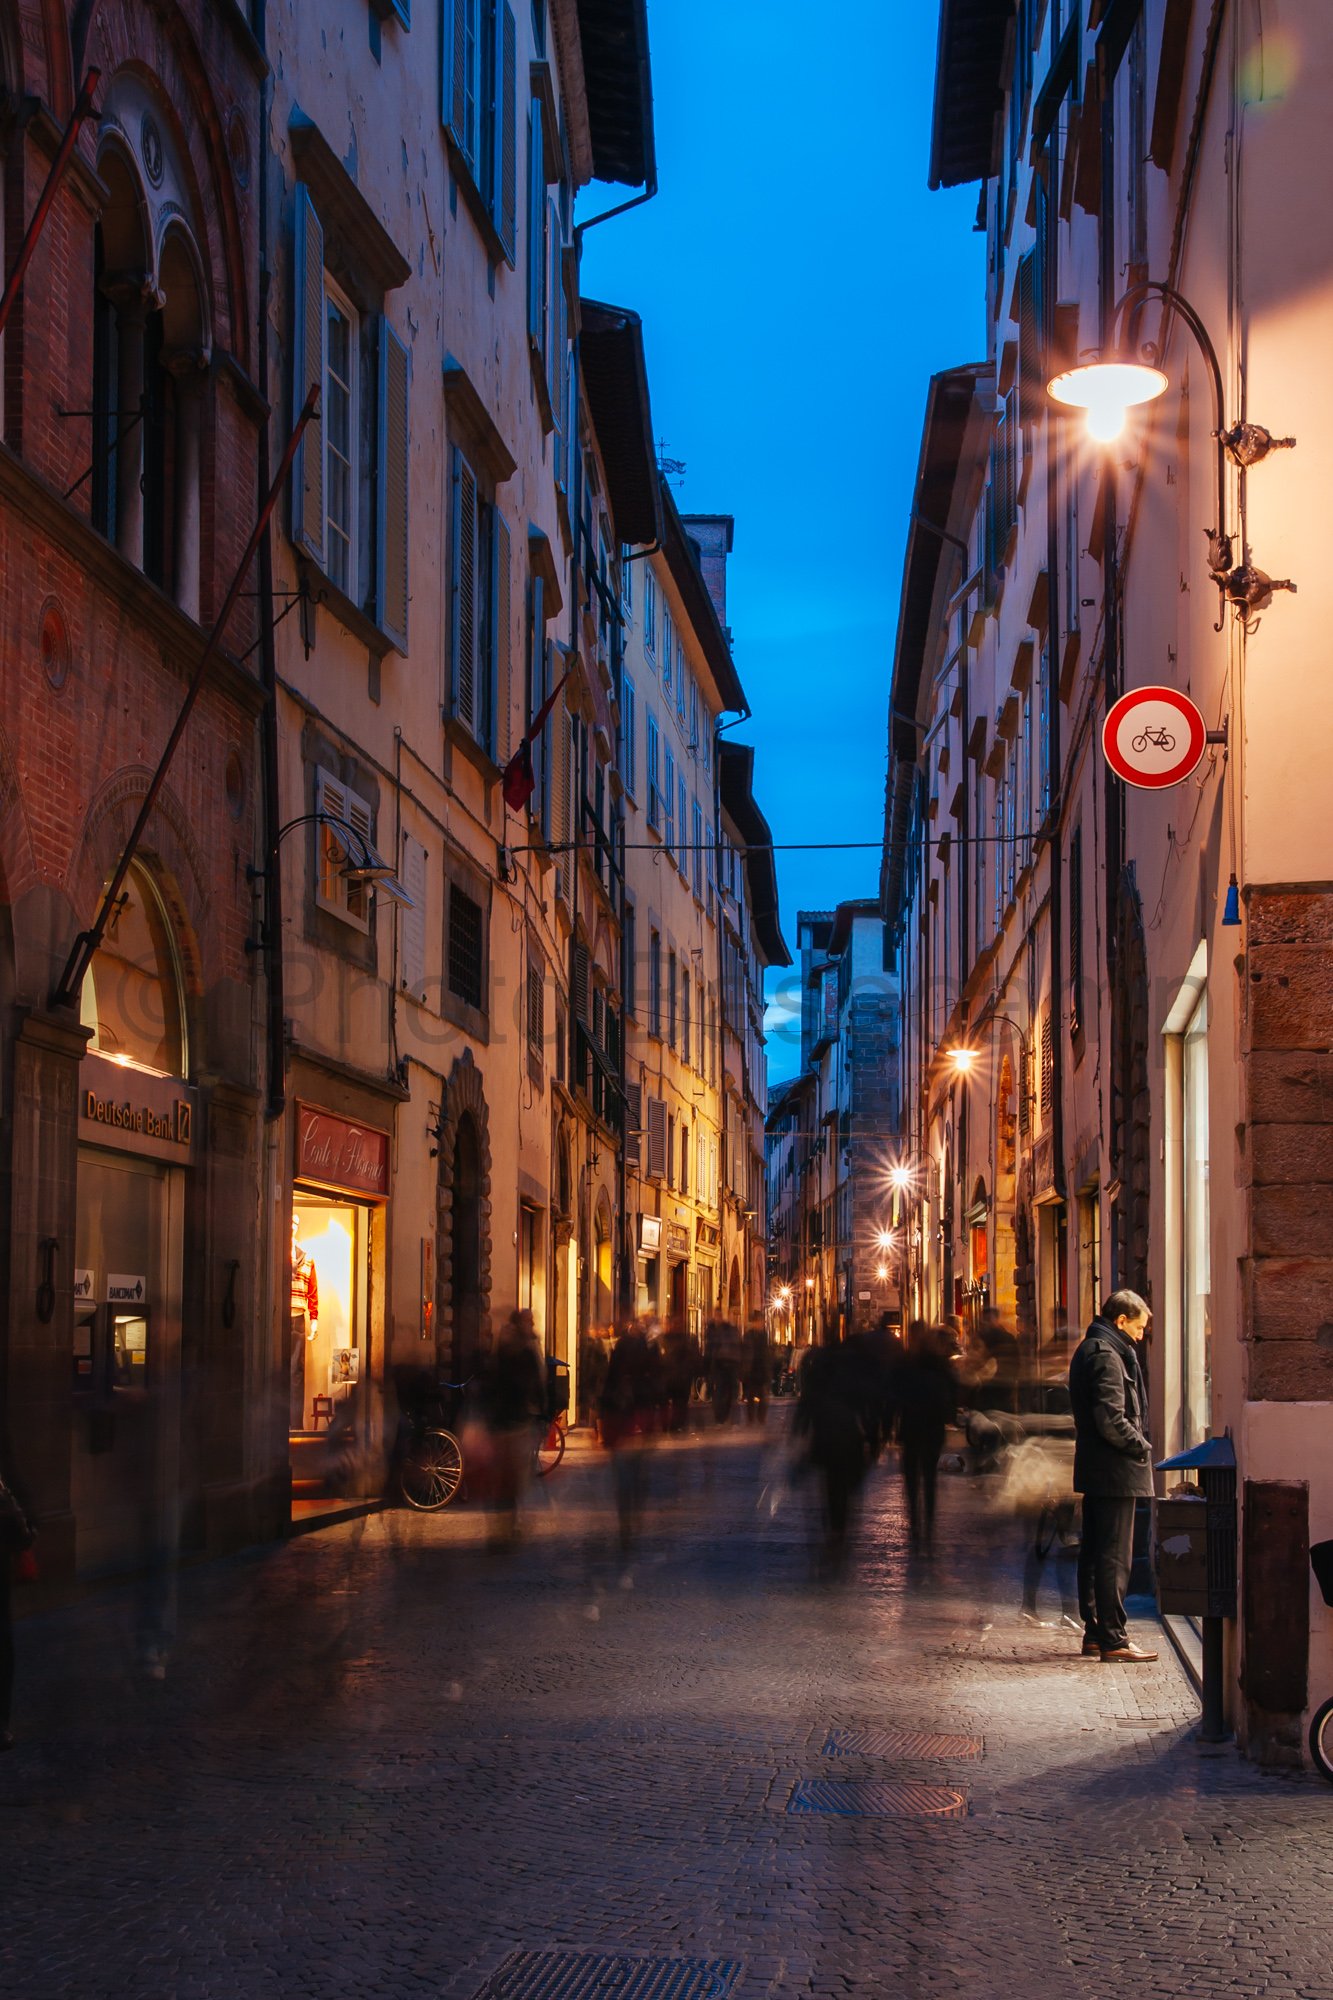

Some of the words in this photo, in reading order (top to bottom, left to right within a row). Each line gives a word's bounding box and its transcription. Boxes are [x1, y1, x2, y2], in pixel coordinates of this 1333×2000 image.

[86, 1090, 143, 1133] Deutsche
[145, 1107, 174, 1139] Bank
[109, 1286, 136, 1300] BANCOMAT
